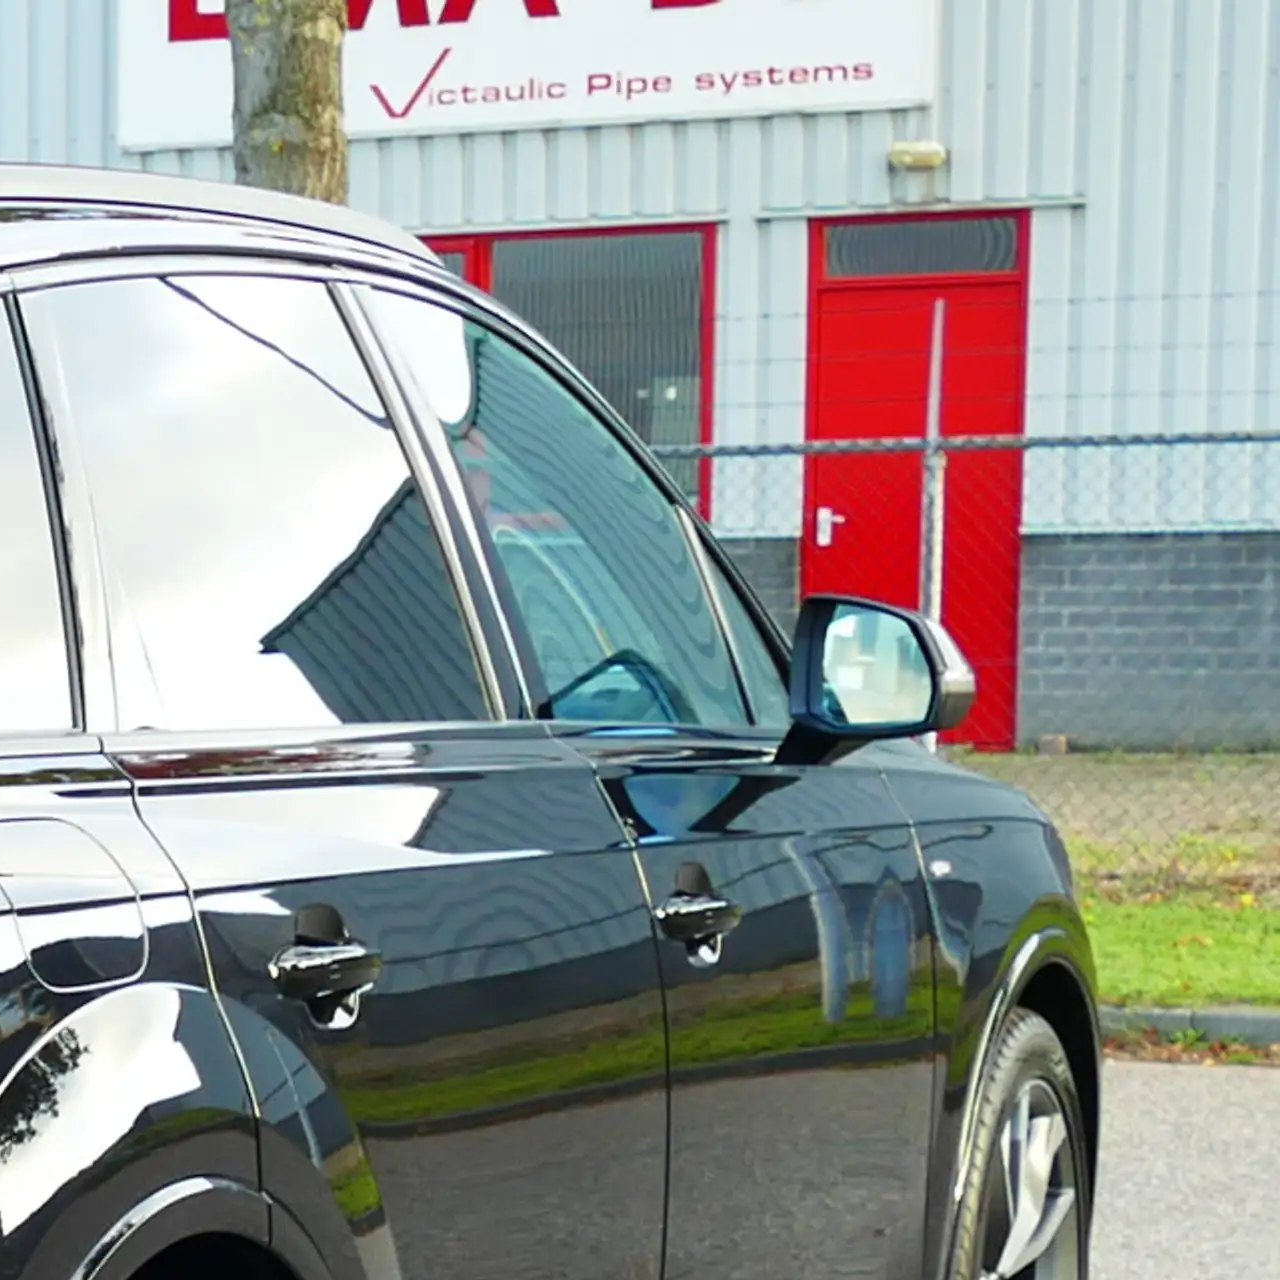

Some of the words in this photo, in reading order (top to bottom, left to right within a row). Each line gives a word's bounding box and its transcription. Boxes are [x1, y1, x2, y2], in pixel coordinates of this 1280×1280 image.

[370, 47, 567, 118] Victaulic
[587, 71, 672, 100] Pipe
[696, 62, 874, 95] systems
